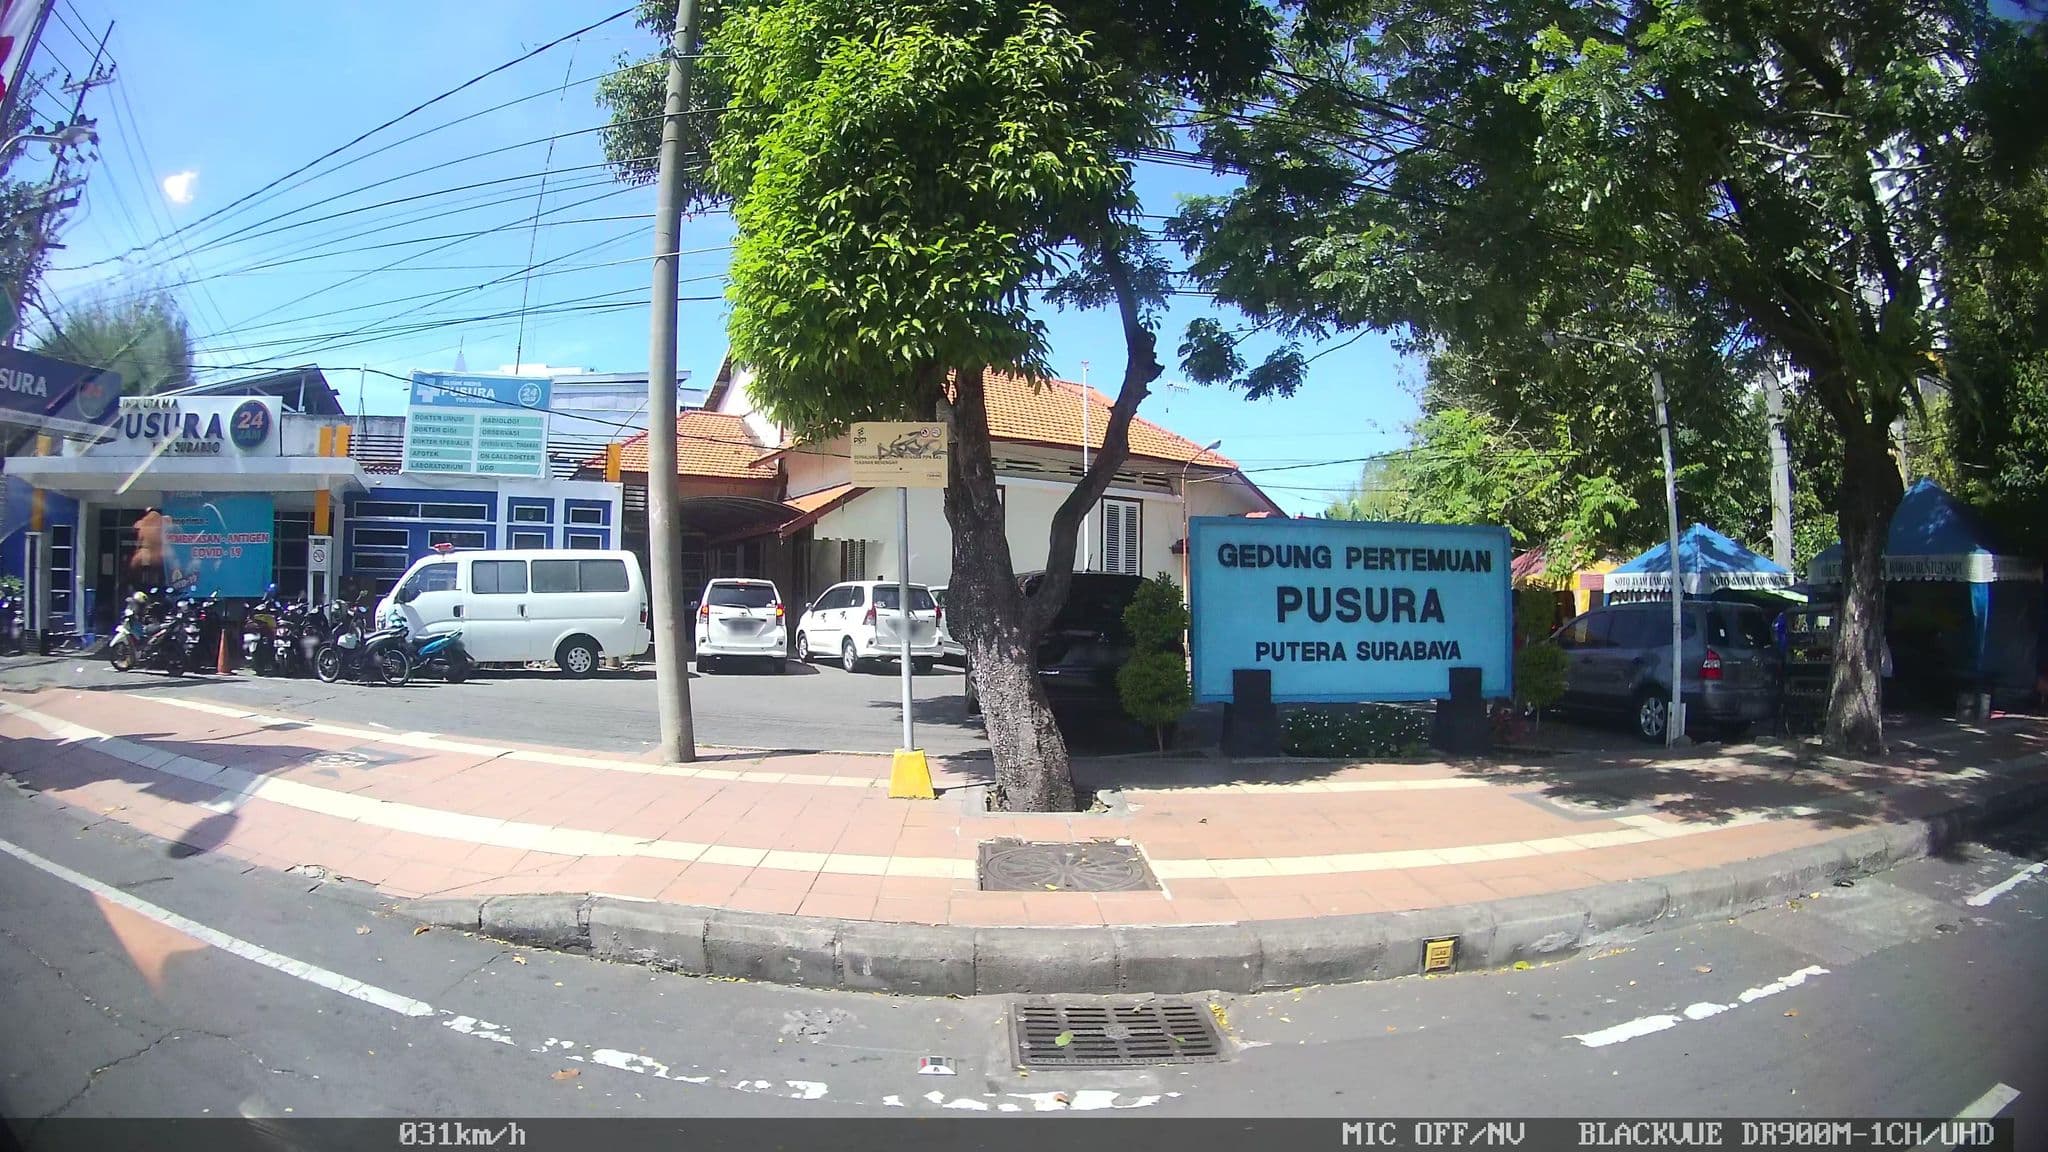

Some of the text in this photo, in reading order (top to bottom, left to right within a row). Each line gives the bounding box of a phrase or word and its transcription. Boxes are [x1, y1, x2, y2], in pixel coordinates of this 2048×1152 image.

[441, 385, 496, 399] PUSURA
[523, 387, 538, 397] 24
[238, 410, 264, 430] 24
[482, 417, 520, 425] RADIOLOGI
[227, 532, 270, 544] ANTIGEN
[192, 546, 223, 558] COVID
[1217, 542, 1492, 573] GEDUNG PERTEMUAN
[1614, 575, 1631, 587] SOTO
[1276, 586, 1446, 624] PUSURA
[1255, 640, 1462, 662] PUTERA SURABAYA
